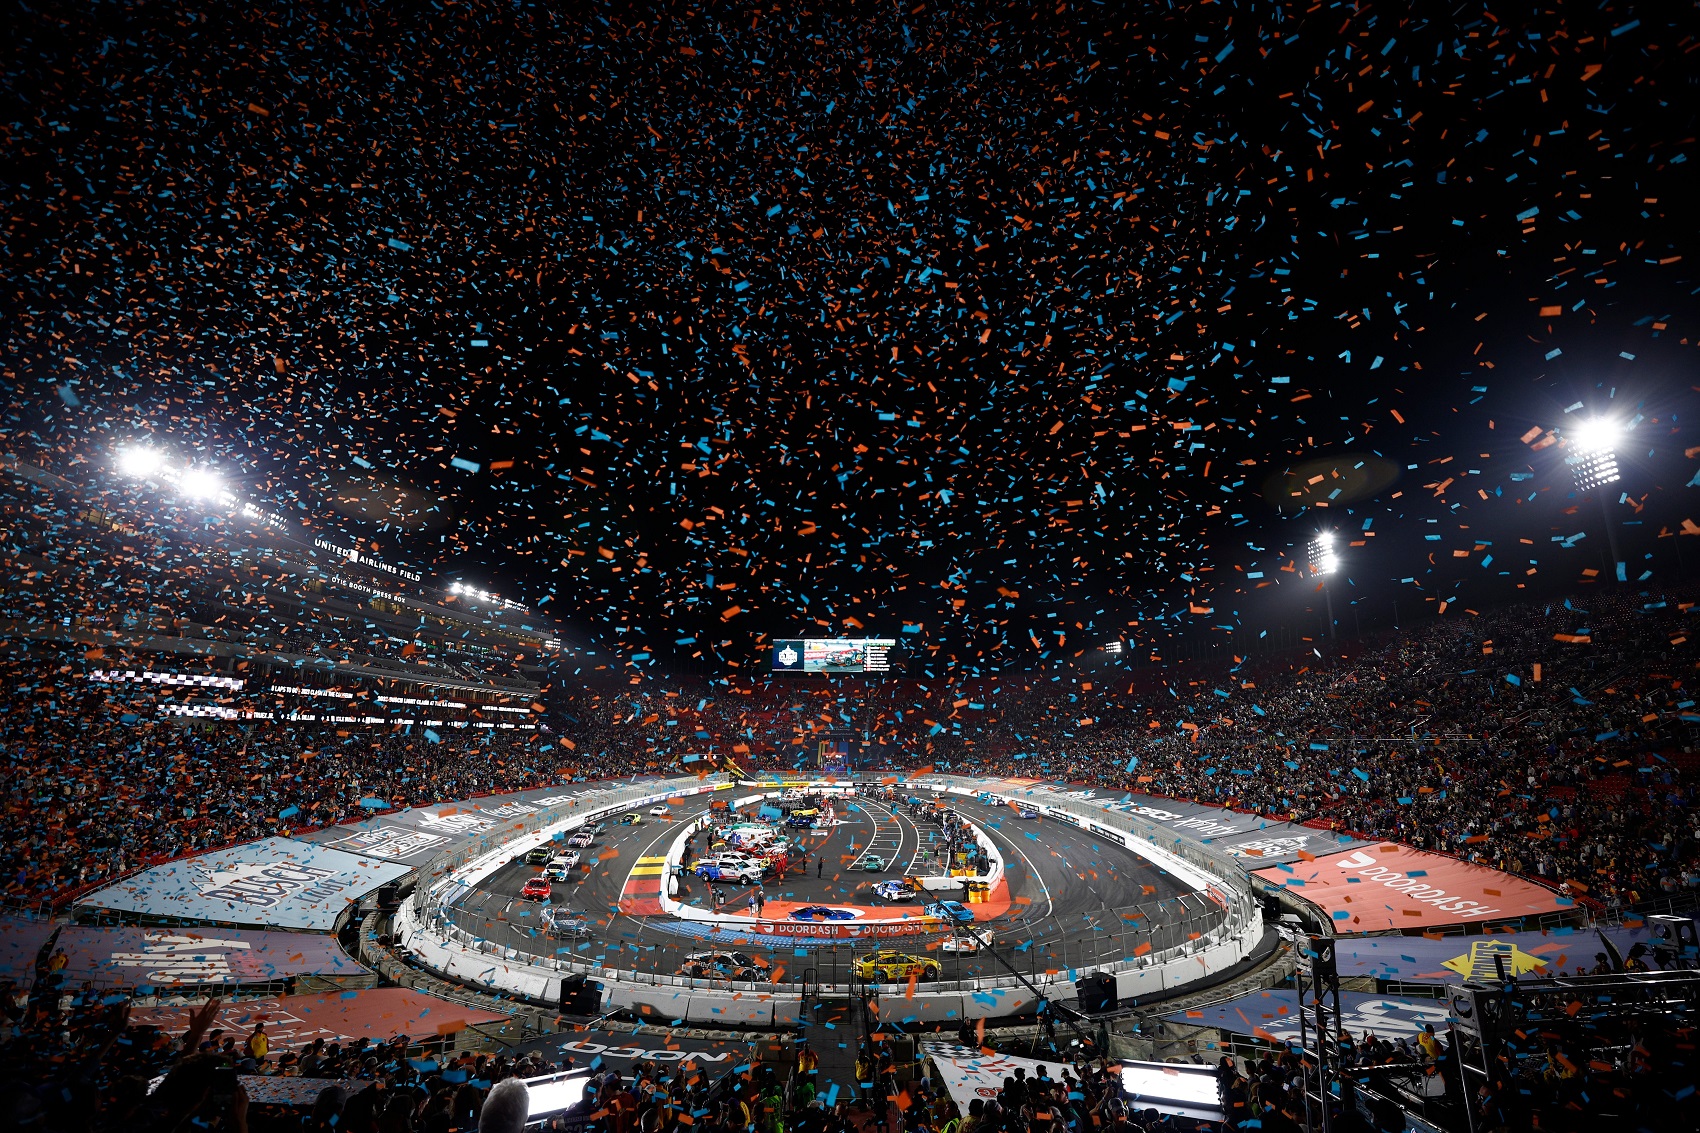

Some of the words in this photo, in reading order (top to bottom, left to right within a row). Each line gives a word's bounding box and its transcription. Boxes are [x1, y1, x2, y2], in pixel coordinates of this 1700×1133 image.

[314, 538, 349, 557] UNITED
[358, 555, 397, 574] AIRLINES
[399, 568, 421, 582] FIELD
[331, 577, 347, 586] OTIS
[348, 581, 371, 593] BOOTH
[372, 589, 392, 600] PRESS
[393, 596, 406, 604] BOX
[203, 864, 335, 906] BUSCH
[293, 878, 352, 904] LIGHT
[1357, 866, 1501, 918] DOORDASH
[779, 924, 838, 935] DOORDASH
[863, 922, 920, 934] DOORDASH
